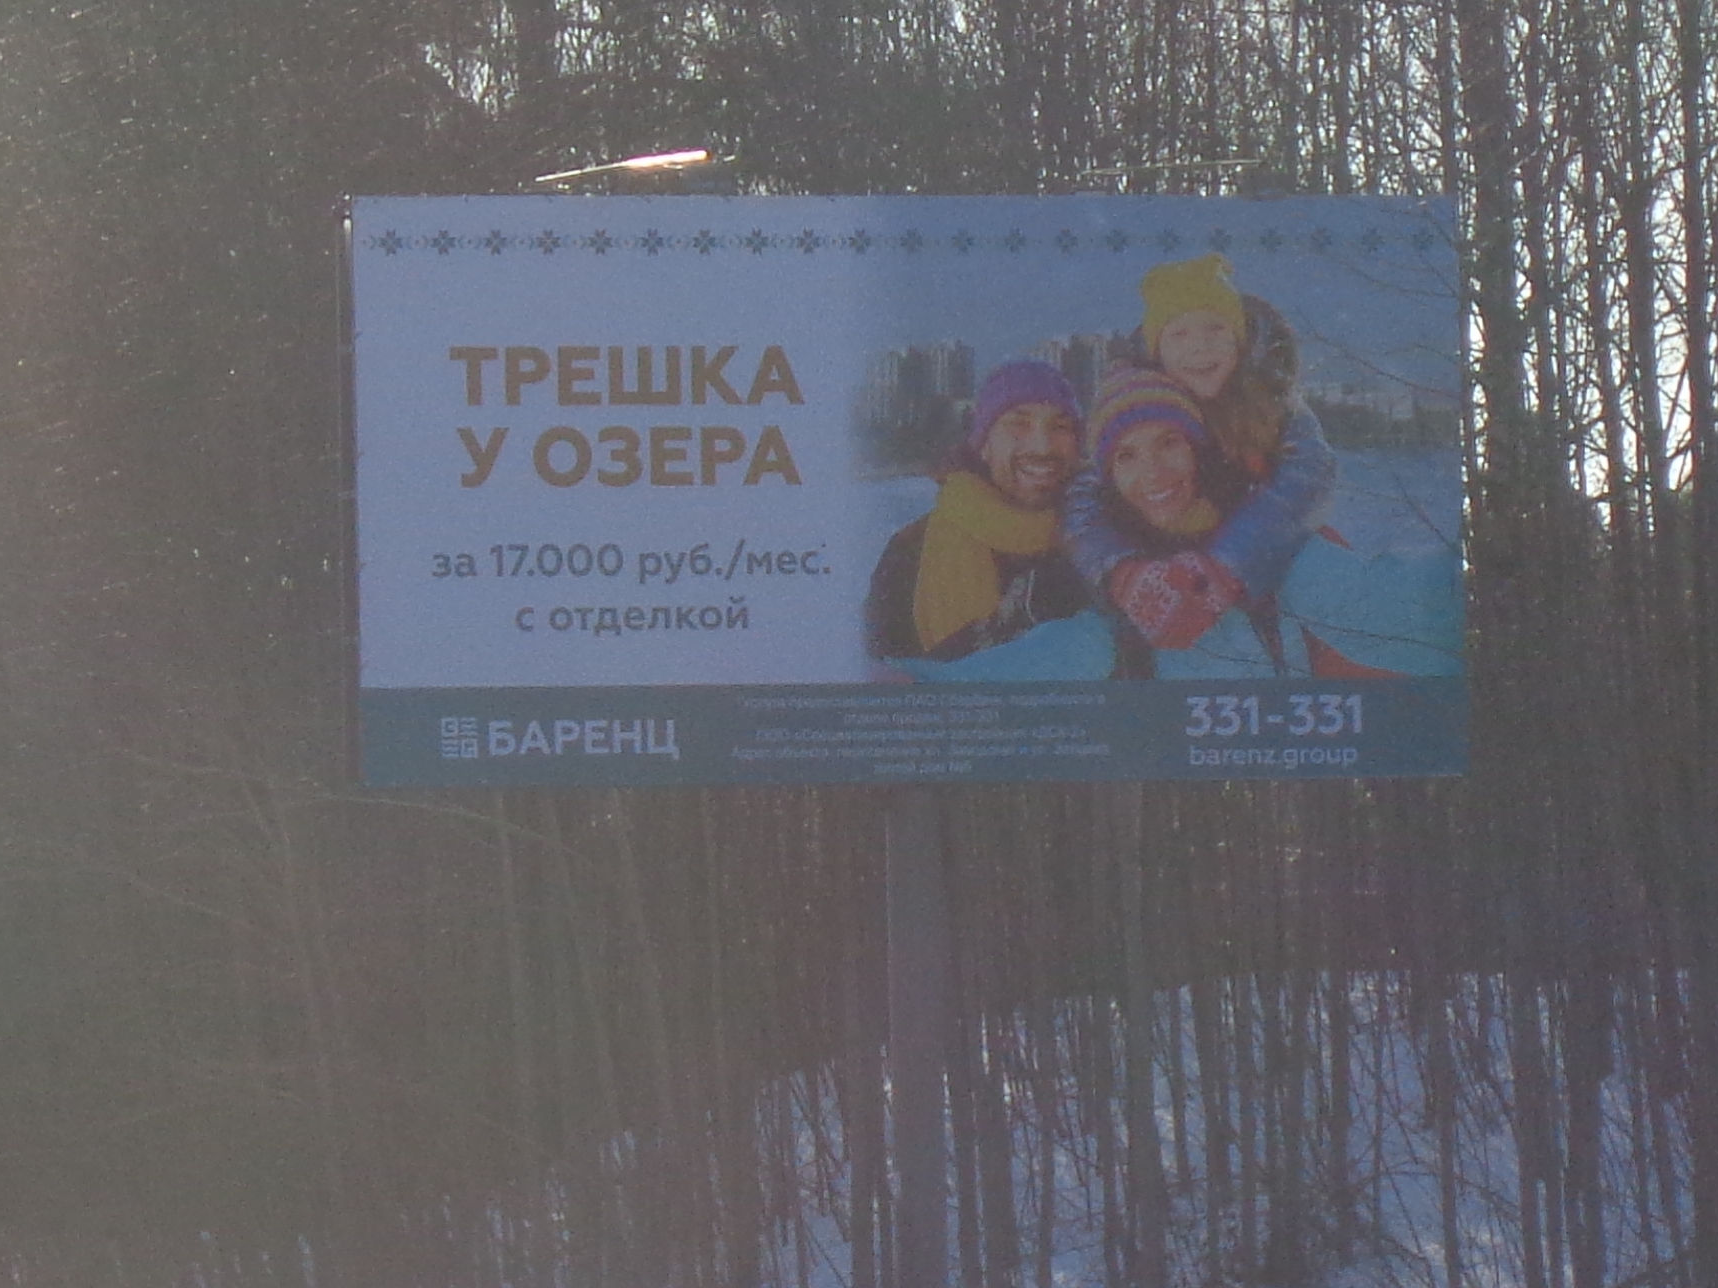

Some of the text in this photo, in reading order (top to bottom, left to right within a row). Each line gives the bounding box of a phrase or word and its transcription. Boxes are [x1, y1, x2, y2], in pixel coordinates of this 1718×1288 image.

[449, 345, 805, 406] ТРЕШКА
[457, 425, 802, 488] У ОЗЕРА
[432, 539, 832, 586] за 17.000 руб./мес.
[515, 595, 749, 637] с отделкой
[1186, 694, 1362, 737] 331-331
[487, 719, 680, 761] БАРЕНЦ
[1188, 744, 1360, 770] barenz.group
